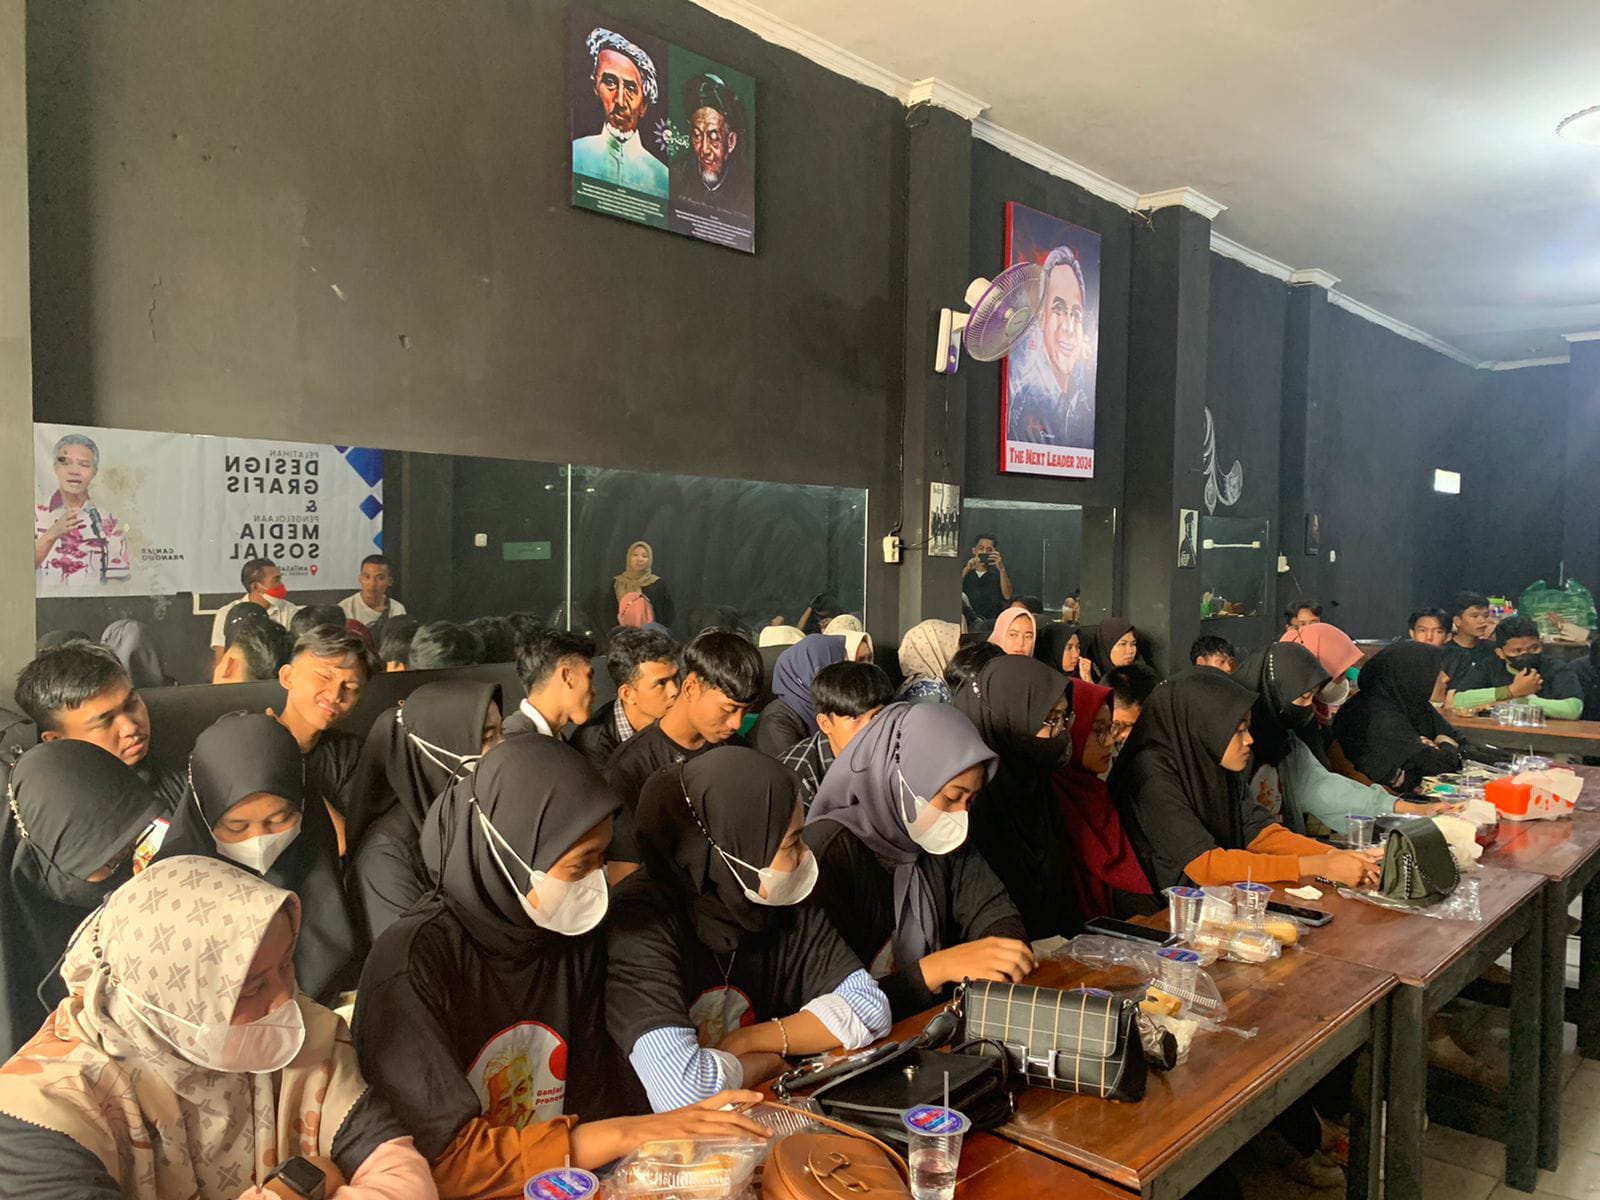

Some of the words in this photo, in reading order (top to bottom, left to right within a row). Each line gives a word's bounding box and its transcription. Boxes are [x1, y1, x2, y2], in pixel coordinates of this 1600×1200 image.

[1047, 451, 1074, 469] LEADER
[1076, 455, 1092, 470] 2024
[536, 1086, 564, 1097] Ganjar
